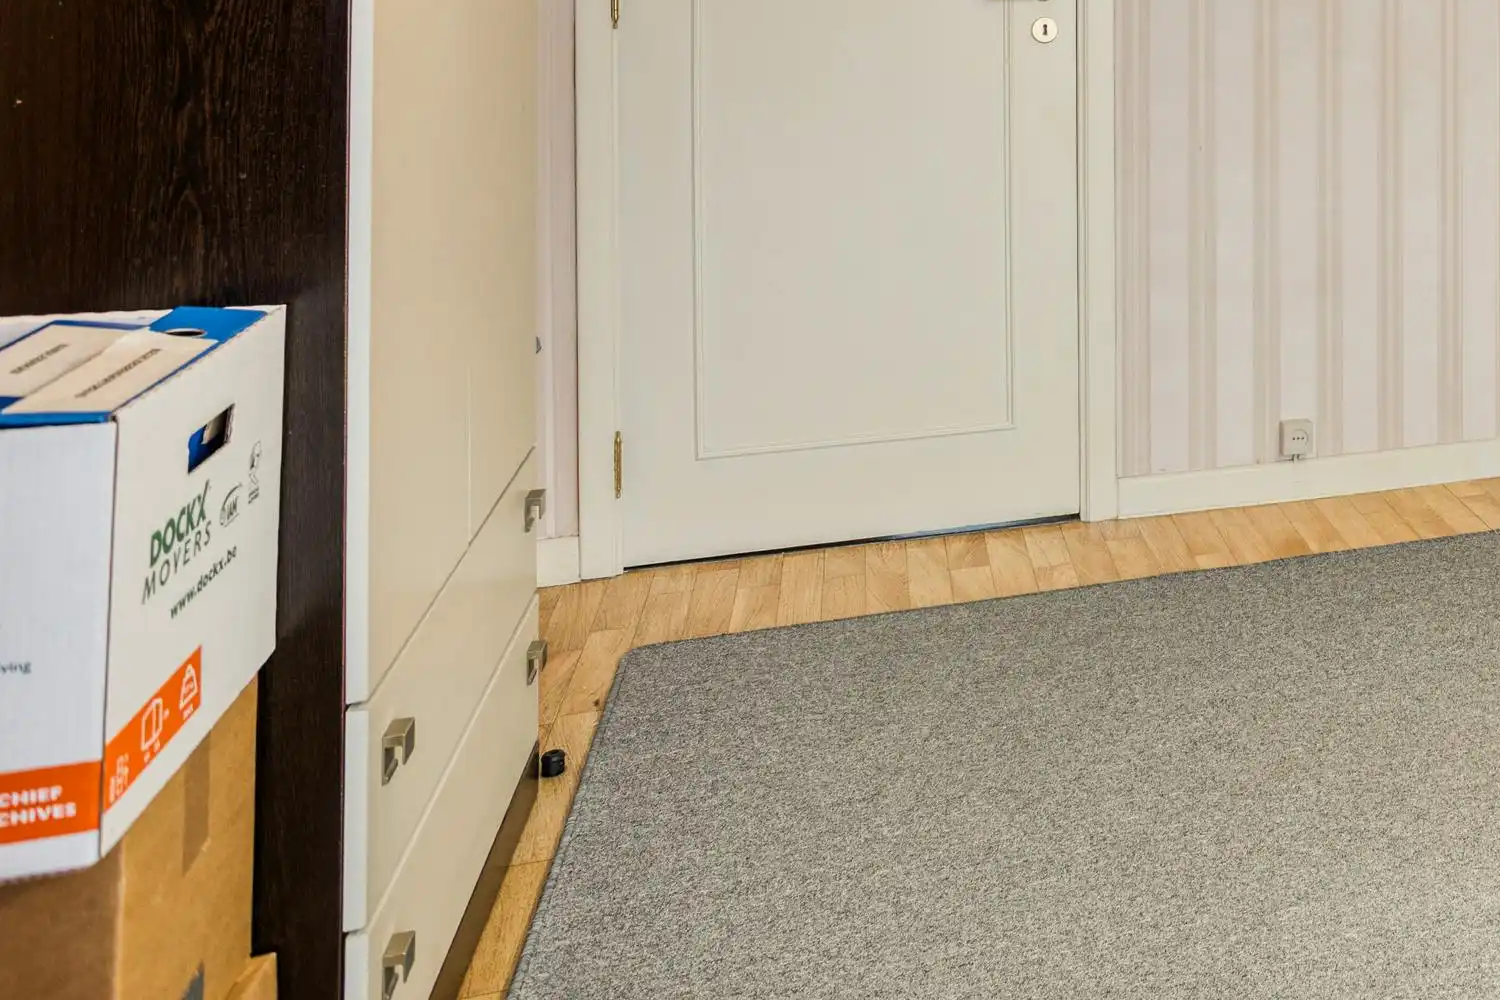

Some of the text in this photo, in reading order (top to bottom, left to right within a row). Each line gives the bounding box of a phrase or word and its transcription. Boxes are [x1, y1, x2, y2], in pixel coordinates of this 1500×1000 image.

[141, 519, 212, 606] MOVERS
[149, 478, 210, 570] DOCKX
[170, 545, 238, 620] www.dockx.be
